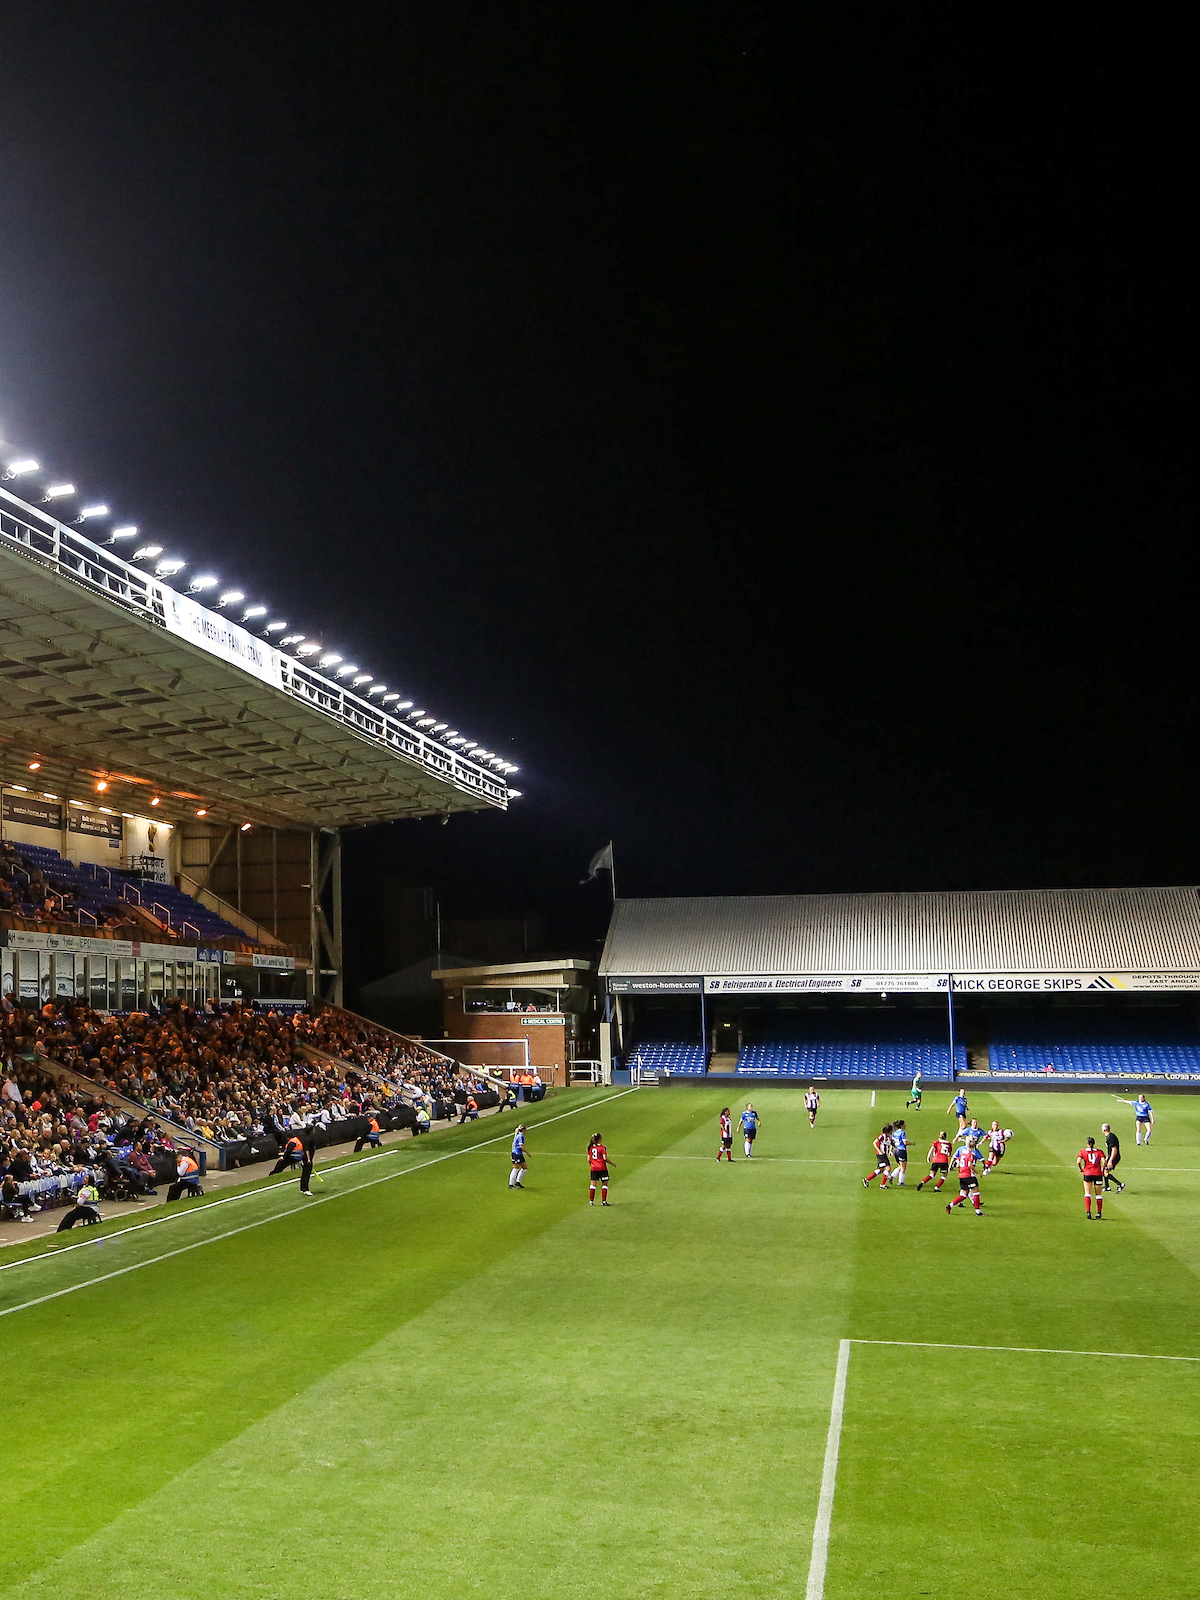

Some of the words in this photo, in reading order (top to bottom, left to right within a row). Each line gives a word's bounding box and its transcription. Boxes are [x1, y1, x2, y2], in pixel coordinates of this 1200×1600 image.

[201, 618, 228, 648] MEERKAT
[246, 644, 263, 668] STAND
[632, 980, 700, 989] weston-homes.com
[709, 980, 720, 989] SB
[722, 980, 770, 989] Refrigeration
[775, 979, 808, 988] Electrical
[808, 979, 843, 988] Engineers
[850, 979, 862, 987] SB
[936, 978, 948, 987] SB
[952, 980, 985, 989] MICK
[988, 979, 1041, 989] GEORGE
[1044, 979, 1082, 989] SKIPS
[592, 1148, 598, 1159] 3
[940, 1143, 949, 1154] 15
[1088, 1153, 1096, 1164] 4
